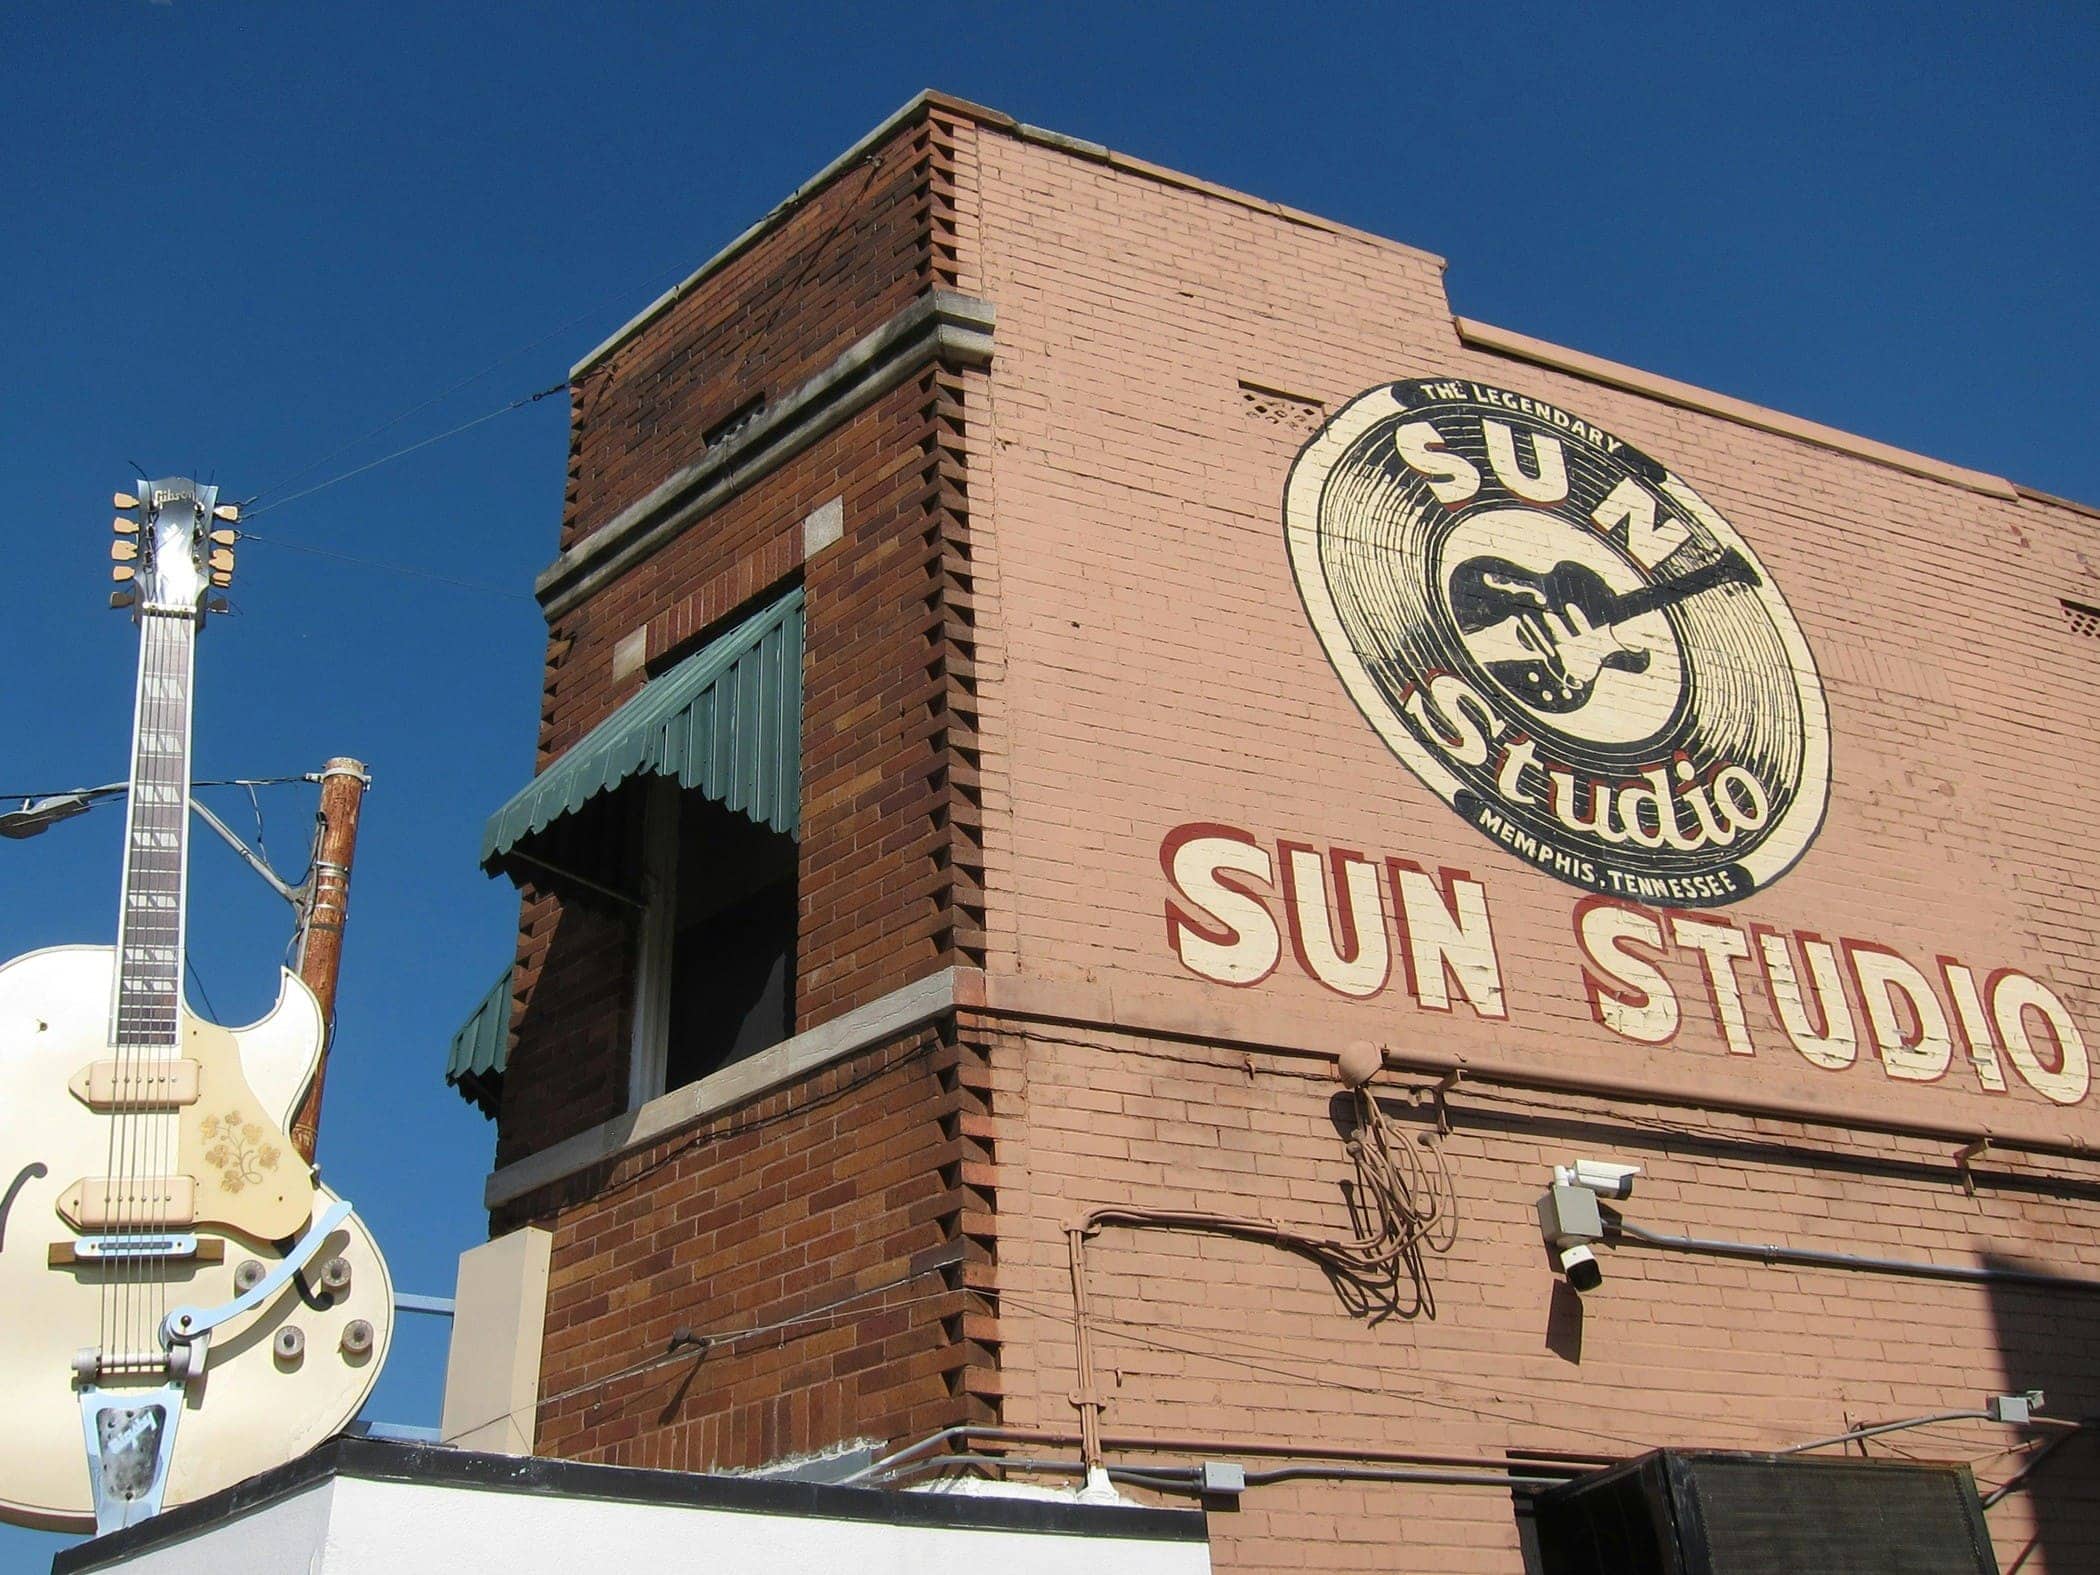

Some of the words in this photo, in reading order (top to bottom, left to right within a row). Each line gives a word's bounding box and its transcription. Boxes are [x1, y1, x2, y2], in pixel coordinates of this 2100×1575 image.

[1419, 380, 1469, 401] THE
[1471, 383, 1624, 454] LEGENDARY
[1395, 418, 1692, 576] SUN
[1402, 668, 1769, 851] Studio
[1607, 869, 1737, 900] TENNESSEE
[1159, 822, 1510, 1022] SUN
[1572, 893, 2091, 1106] STUDIO
